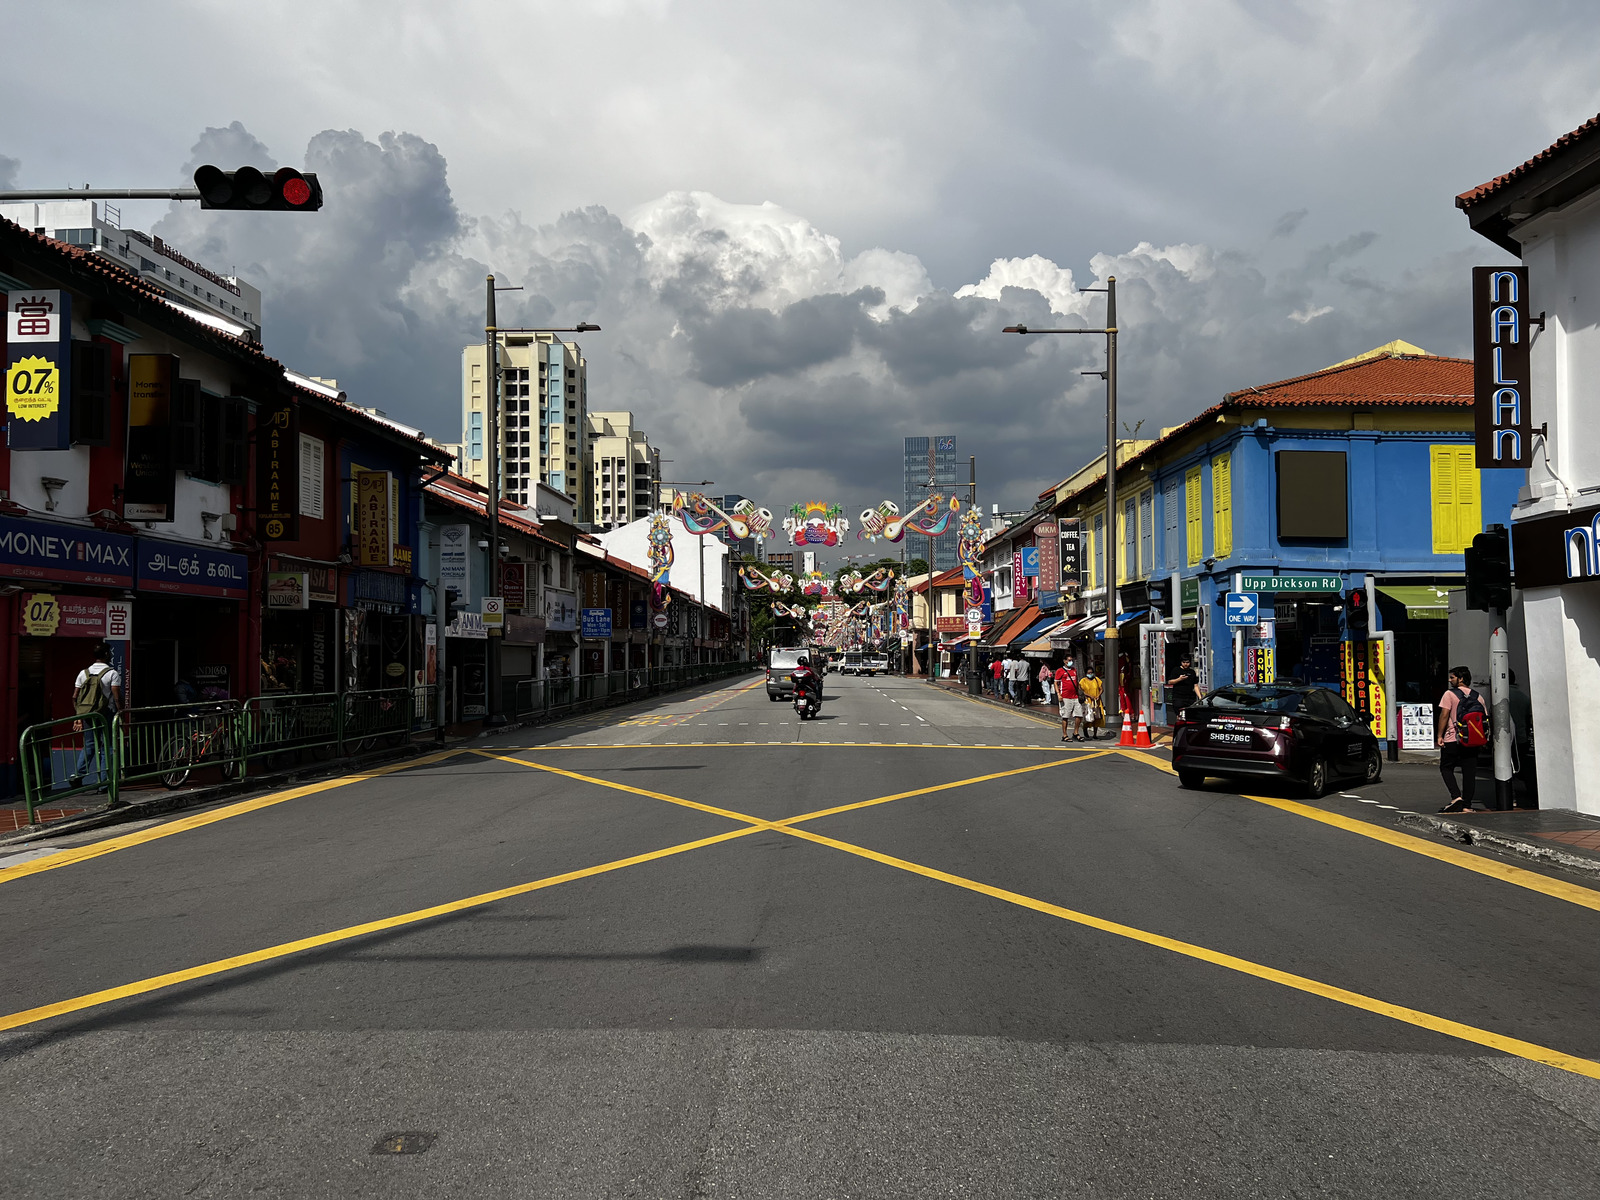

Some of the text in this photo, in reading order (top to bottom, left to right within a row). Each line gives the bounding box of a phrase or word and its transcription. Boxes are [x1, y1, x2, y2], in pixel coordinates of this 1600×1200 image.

[12, 368, 54, 395] 0.7%
[270, 429, 281, 512] ABIRAAME
[268, 523, 282, 534] 85
[368, 494, 380, 562] ABIRAAME
[1060, 531, 1080, 540] COFFEE,
[0, 531, 75, 560] MONEY
[85, 541, 130, 567] MAX
[393, 547, 412, 563] AAME
[1066, 543, 1075, 551] TEA
[206, 562, 242, 580] கடை
[1244, 577, 1337, 590] Upp Dickson Rd
[30, 601, 55, 622] 0.7%
[583, 615, 611, 623] Bus Lane
[1228, 614, 1256, 623] ONE WAY
[1372, 643, 1380, 679] MONEY
[1374, 686, 1382, 736] CHANGER
